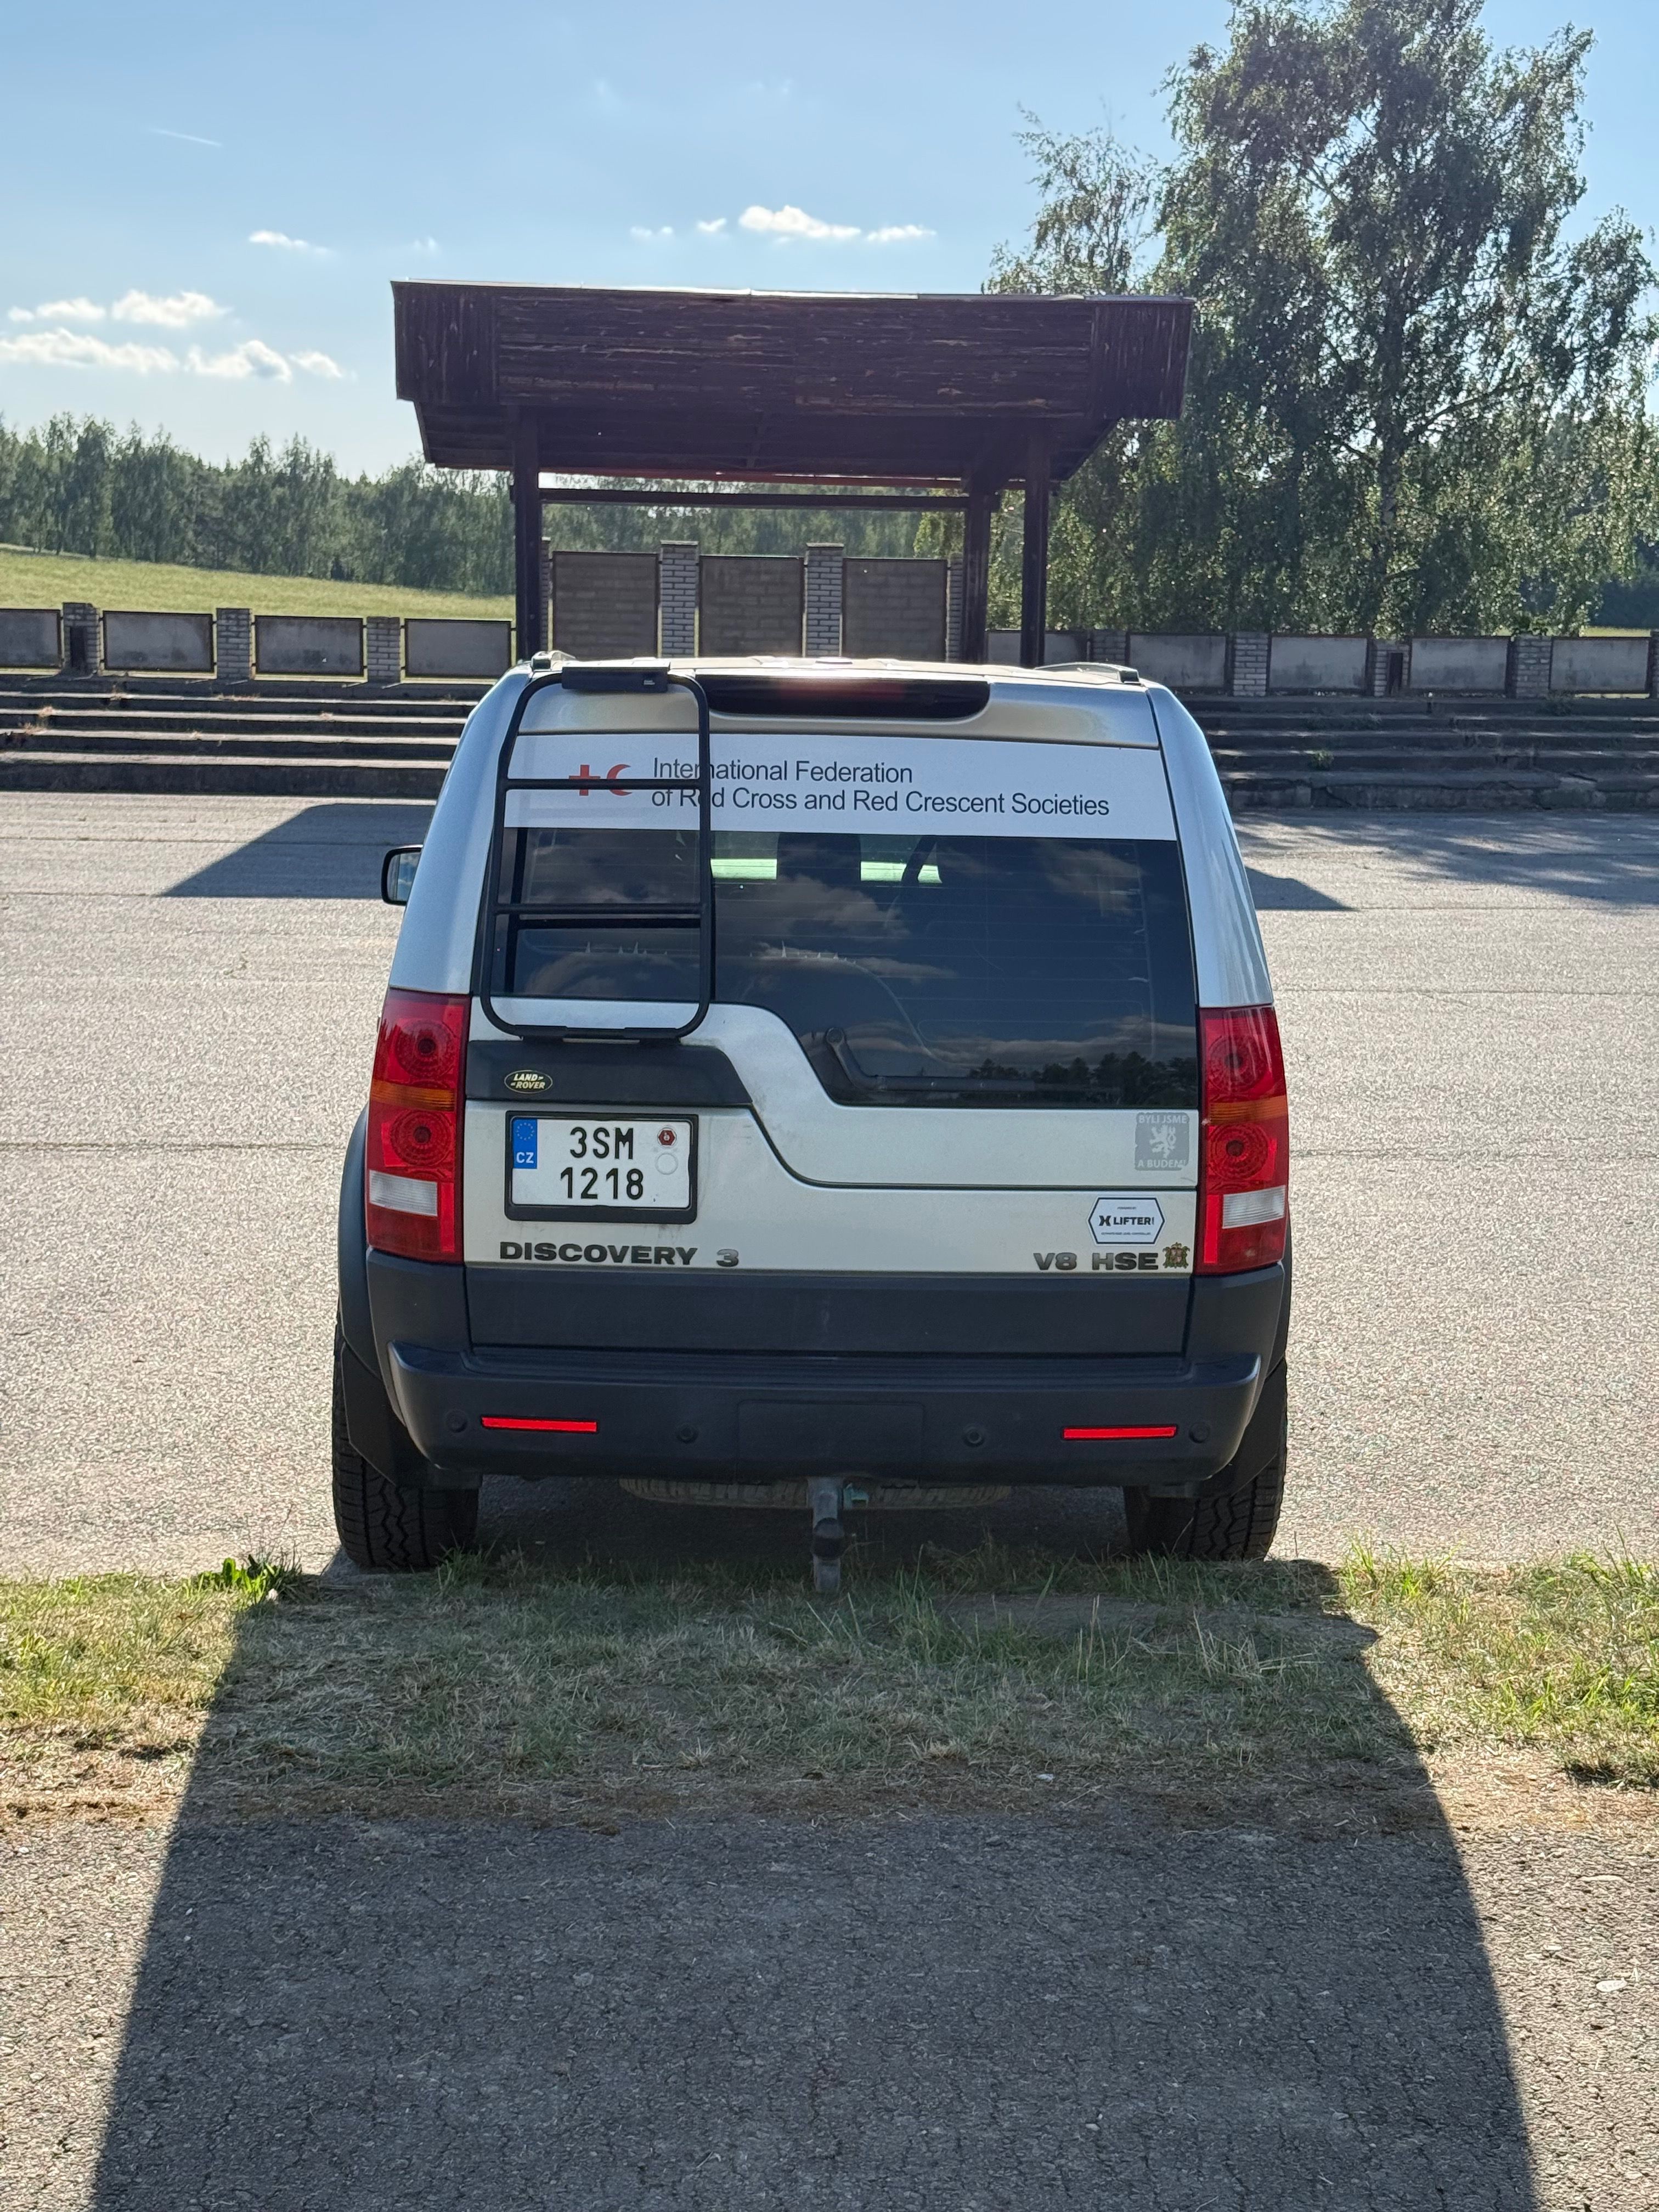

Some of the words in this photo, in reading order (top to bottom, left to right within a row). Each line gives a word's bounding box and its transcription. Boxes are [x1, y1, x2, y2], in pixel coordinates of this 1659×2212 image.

[796, 760, 912, 783] Federation
[680, 787, 724, 808] Rd
[732, 787, 798, 809] Cross
[804, 789, 845, 810] and
[854, 789, 898, 811] Red
[905, 791, 1005, 813] Crescent
[1012, 793, 1109, 816] Societies
[1138, 1114, 1160, 1124] BYLI
[1161, 1114, 1187, 1124] JSME
[570, 1126, 634, 1159] 3SM
[516, 1152, 534, 1164] CZ
[560, 1167, 644, 1200] 1218
[499, 1241, 698, 1266] DISCOVERY
[716, 1248, 739, 1268] 3
[1033, 1252, 1077, 1271] V8
[1091, 1252, 1159, 1271] HSE
